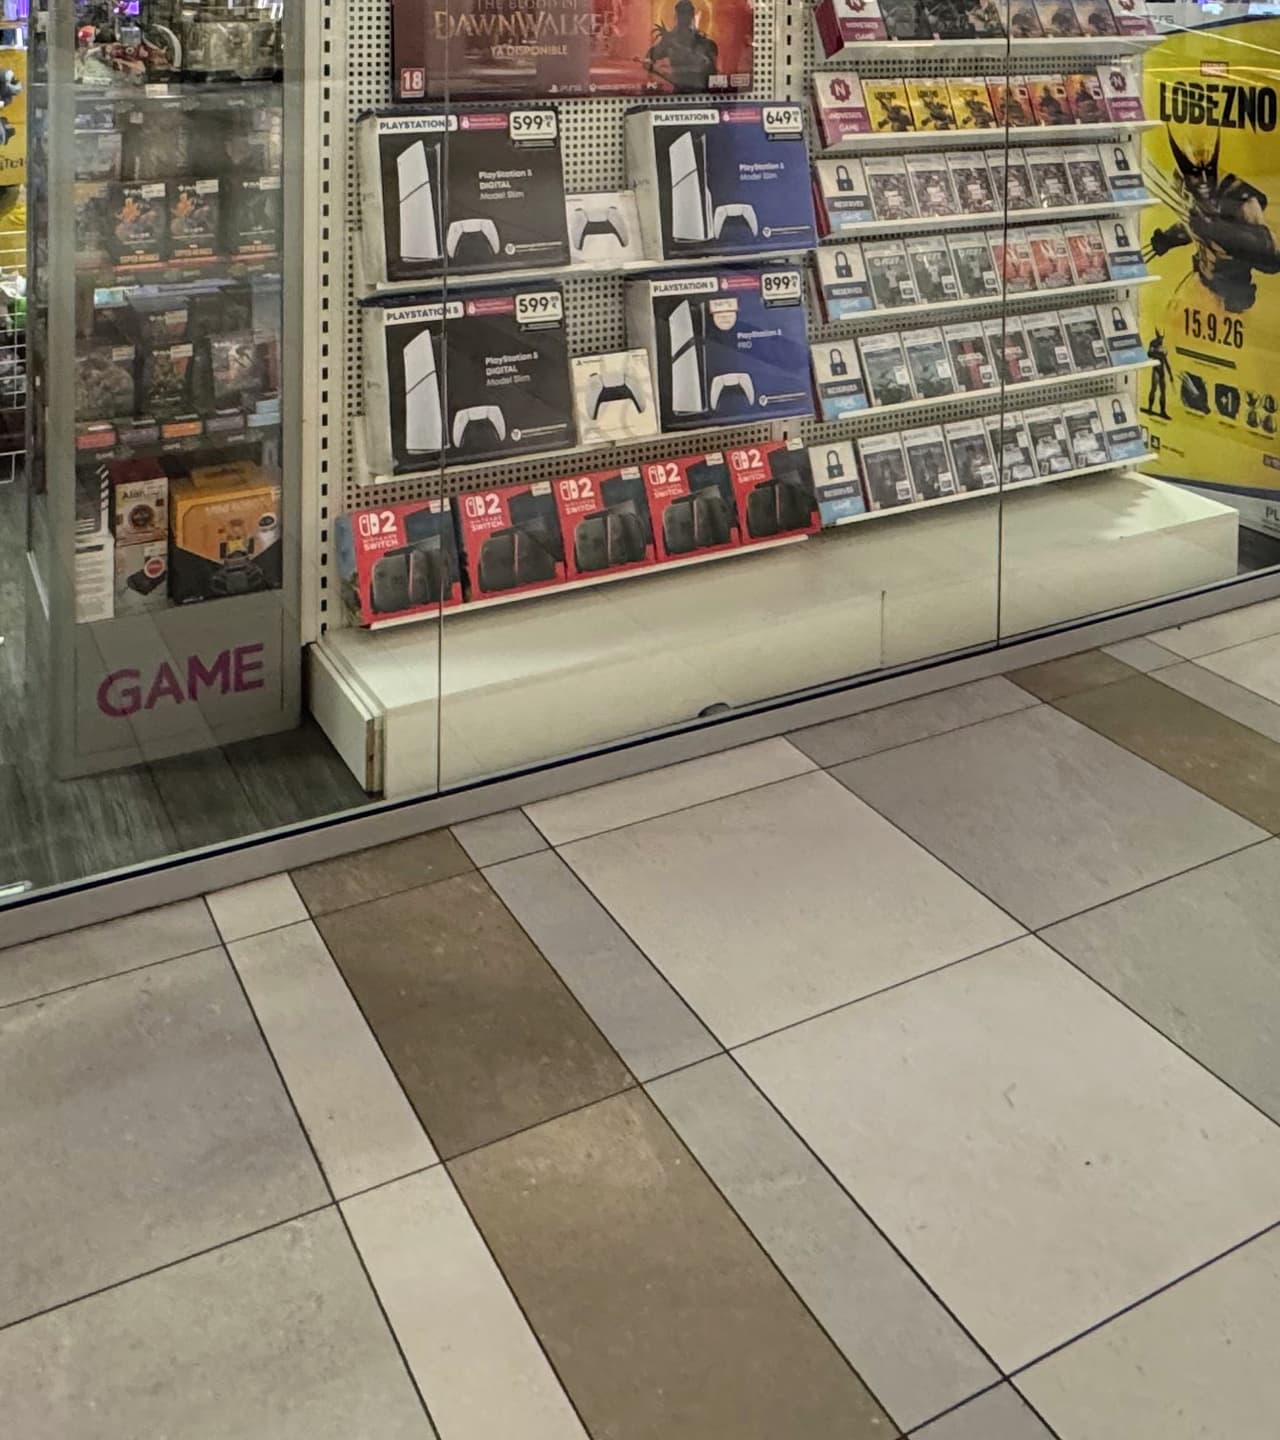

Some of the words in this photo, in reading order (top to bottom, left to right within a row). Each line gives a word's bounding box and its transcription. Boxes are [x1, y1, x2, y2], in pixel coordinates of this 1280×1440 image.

[433, 10, 624, 40] DAWNWALKER
[506, 44, 568, 58] DISPONIBLE
[402, 69, 422, 90] 18
[1159, 81, 1278, 133] LOBEZNO
[654, 113, 709, 122] PLAYSTATION
[379, 120, 446, 130] PLAYSTATION
[478, 170, 526, 180] PlayStation
[479, 181, 512, 190] DIGITAL
[653, 282, 708, 293] PLAYSTATION
[386, 308, 451, 321] PLAYSTATION
[1184, 307, 1244, 349] 15.9.26
[485, 366, 518, 375] DIGITAL
[668, 462, 681, 482] 2
[577, 477, 595, 498] 2
[653, 488, 684, 498] SWITCH
[484, 493, 503, 516] 2
[565, 503, 597, 515] SWITCH
[380, 511, 398, 534] 2
[470, 520, 505, 532] SWITCH
[363, 539, 399, 551] SWITCH
[96, 643, 265, 718] GAME
